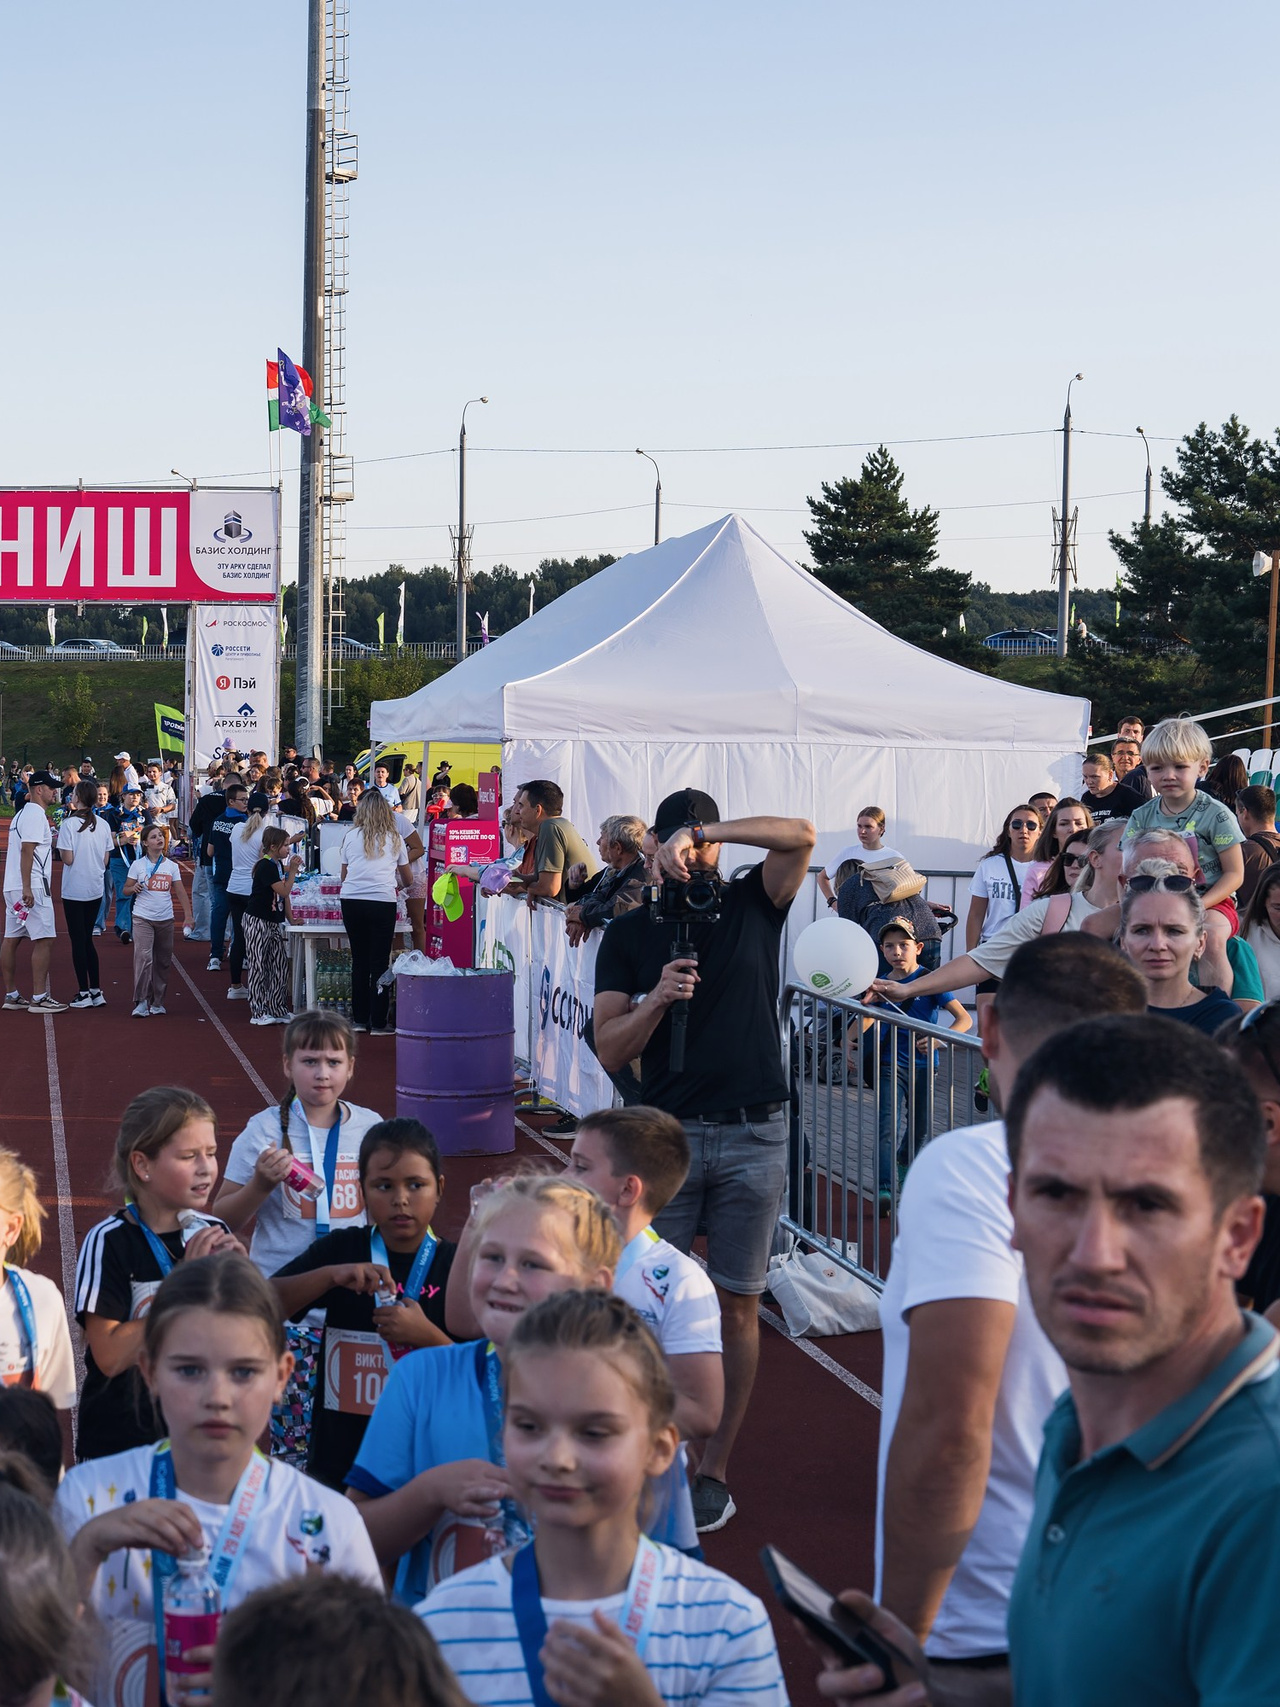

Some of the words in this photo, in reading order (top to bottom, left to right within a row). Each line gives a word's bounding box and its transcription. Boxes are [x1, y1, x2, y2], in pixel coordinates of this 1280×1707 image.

[195, 547, 226, 555] БАЗИС
[227, 547, 272, 556] ХОЛДИНГ
[247, 563, 272, 571] СДЕЛАЛ
[243, 572, 271, 580] ХОЛДИНГ
[233, 677, 256, 689] Пэй
[214, 720, 257, 728] АРХБУМ
[152, 880, 169, 889] 2418
